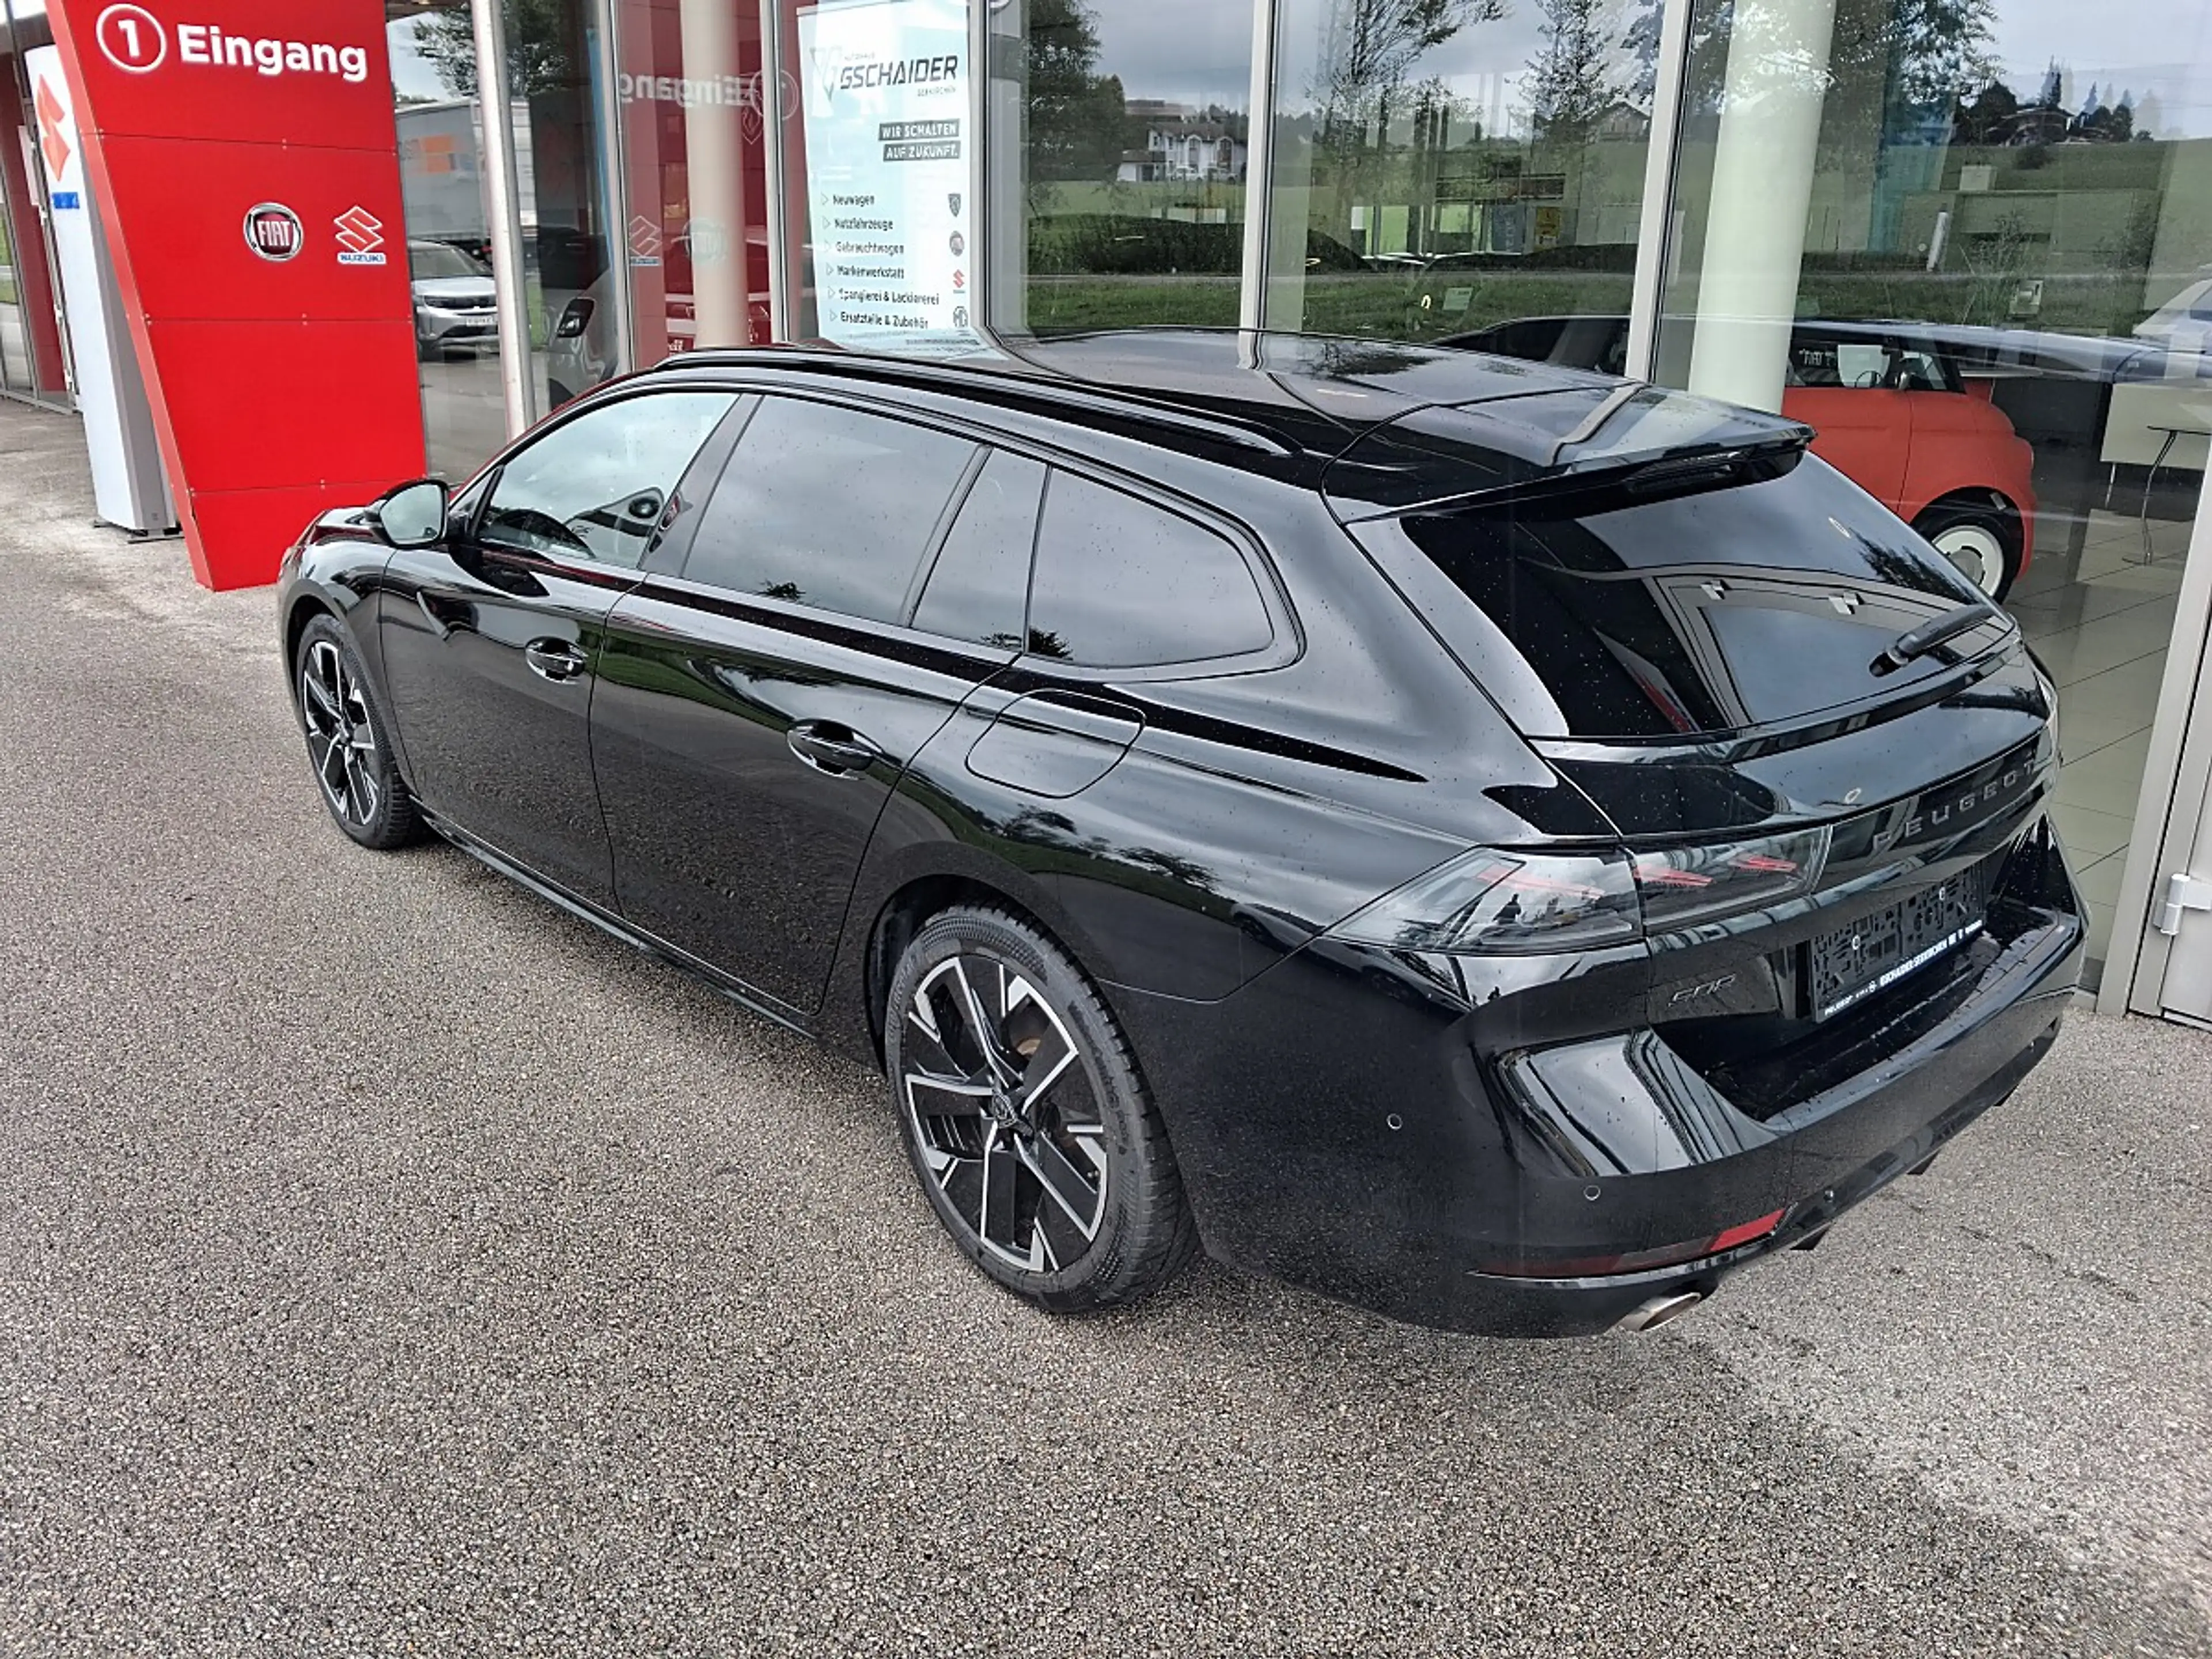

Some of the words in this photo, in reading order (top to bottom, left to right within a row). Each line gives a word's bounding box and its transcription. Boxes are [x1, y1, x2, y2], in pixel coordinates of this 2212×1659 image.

[118, 20, 141, 58] 1
[177, 24, 368, 82] Eingang
[840, 55, 958, 89] GSCHAIDER
[881, 126, 900, 139] WIR
[904, 122, 957, 137] SCHALTEN
[886, 147, 906, 159] AUF
[833, 194, 874, 207] Neuwagen
[256, 221, 290, 246] FIAT
[340, 254, 384, 262] SUZUKI
[884, 291, 889, 301] &
[1873, 759, 2035, 850] PEUGEOT
